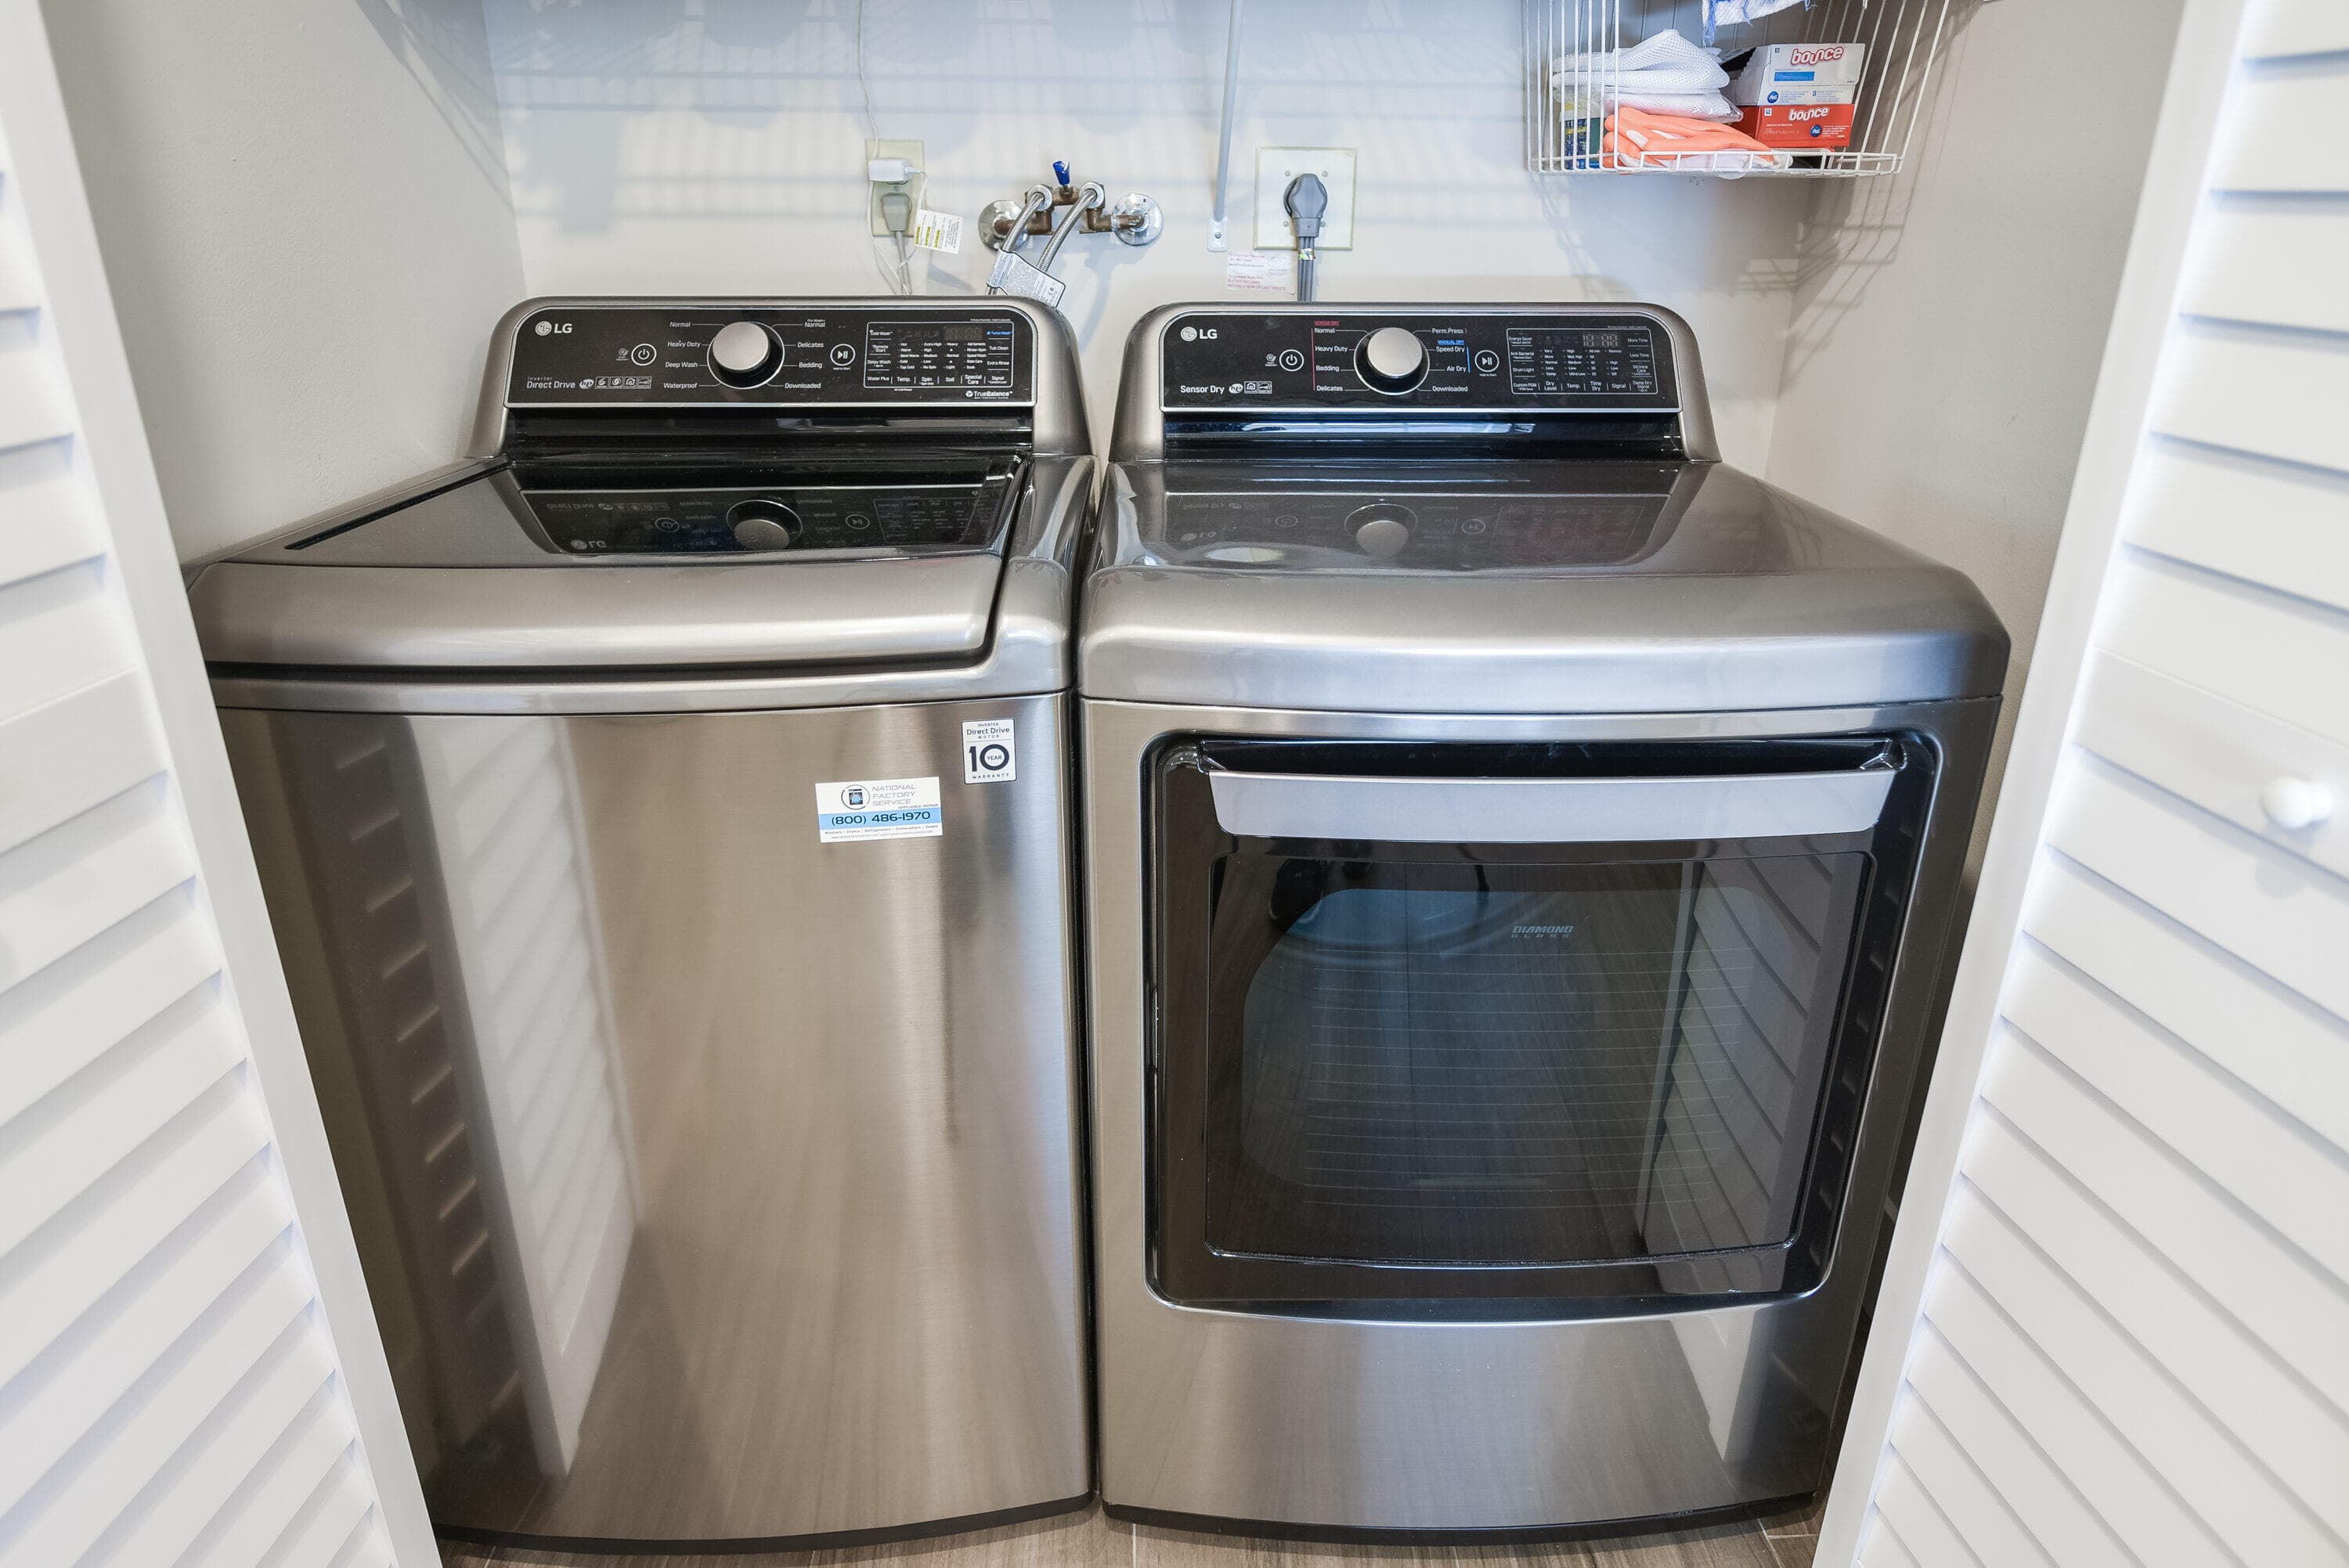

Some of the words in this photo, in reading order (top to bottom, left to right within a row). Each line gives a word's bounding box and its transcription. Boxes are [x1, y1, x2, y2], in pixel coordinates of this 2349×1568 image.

[1791, 47, 1844, 65] bounce
[1788, 107, 1829, 121] bounce
[554, 323, 572, 333] LG
[1200, 329, 1218, 339] LG
[1210, 385, 1225, 395] Dry
[969, 744, 1010, 772] 10
[871, 798, 911, 807] SERVICE
[832, 815, 867, 826] (800)
[871, 811, 931, 822] 486-1970
